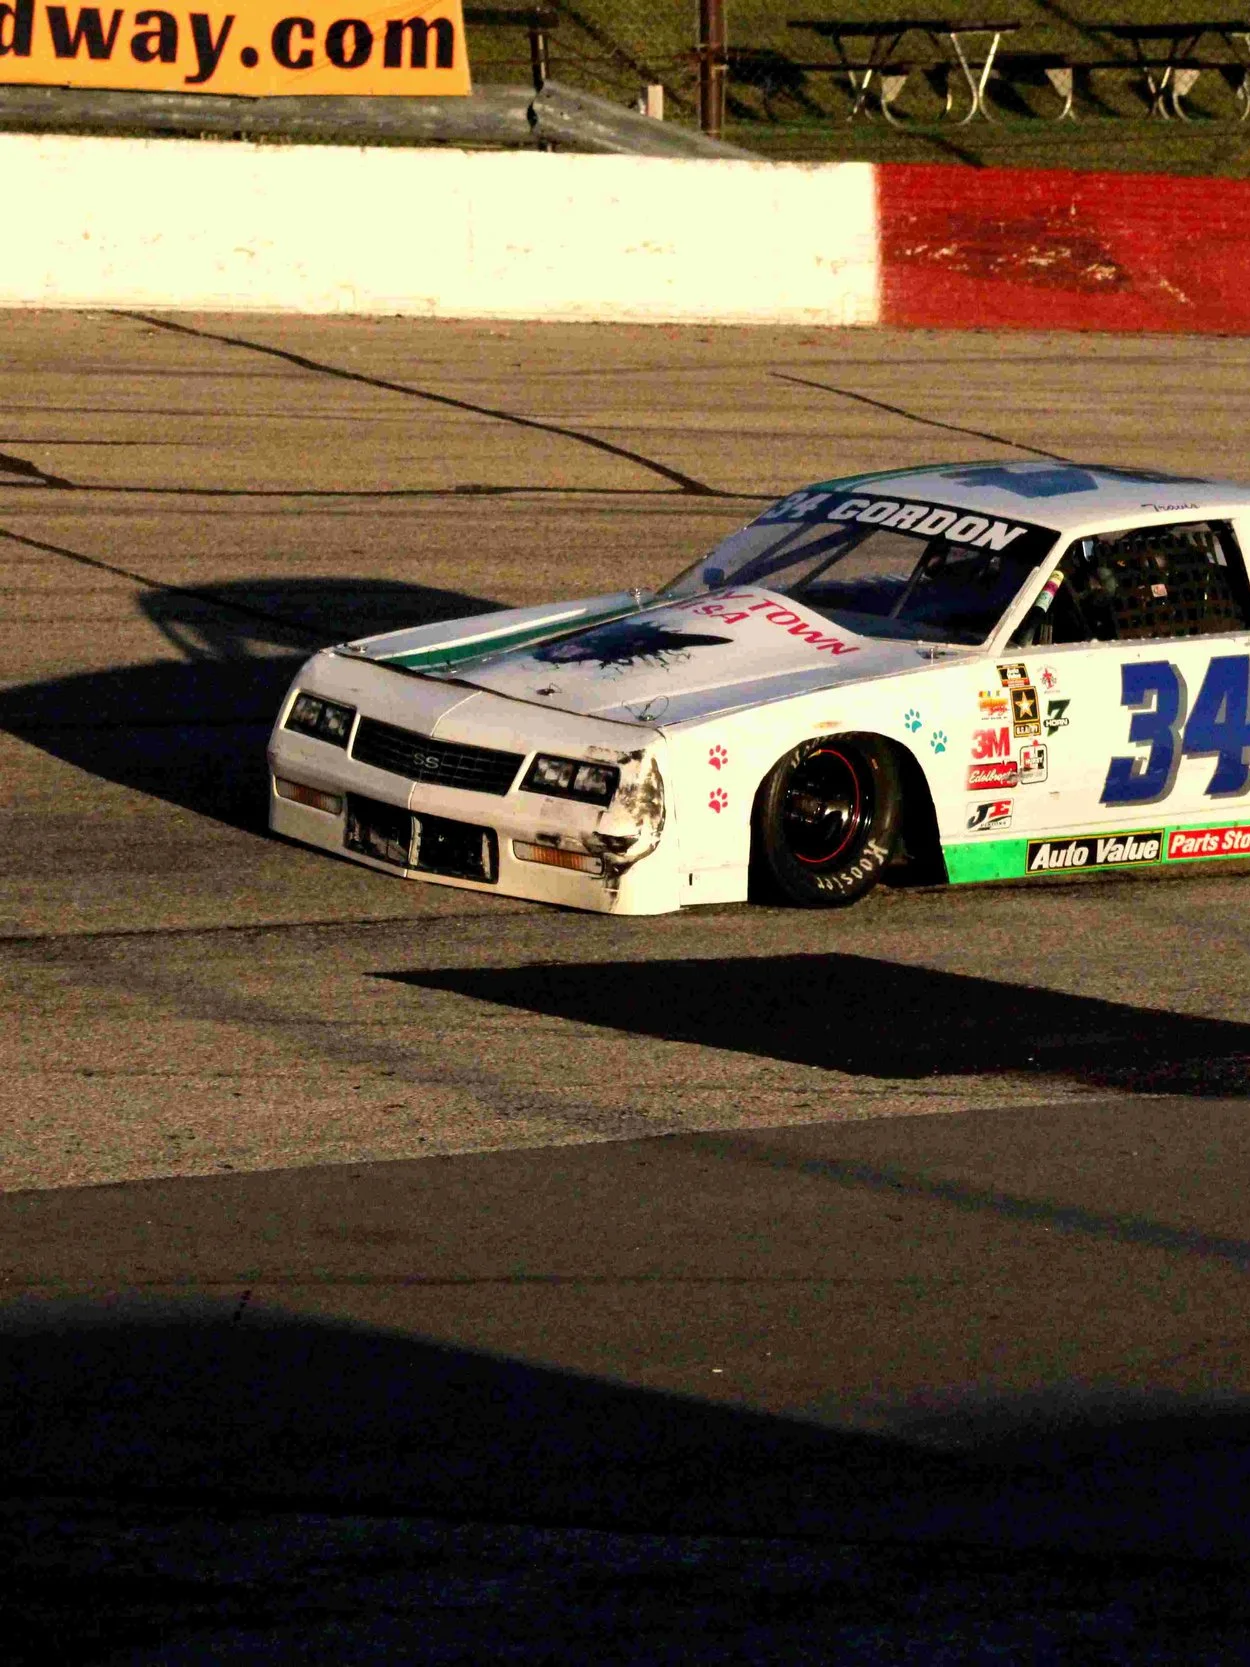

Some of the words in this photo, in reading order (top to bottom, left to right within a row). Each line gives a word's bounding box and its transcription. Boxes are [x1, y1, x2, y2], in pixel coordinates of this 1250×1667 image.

[767, 493, 832, 519] 34
[827, 499, 1028, 550] GORDON
[748, 598, 861, 655] TOWN
[971, 727, 1010, 759] 3M
[413, 751, 439, 771] SS
[967, 800, 1011, 829] JE
[1029, 842, 1089, 870] Auto
[1095, 838, 1159, 865] Value
[1170, 834, 1219, 854] Parts
[815, 838, 888, 894] Hoosier
